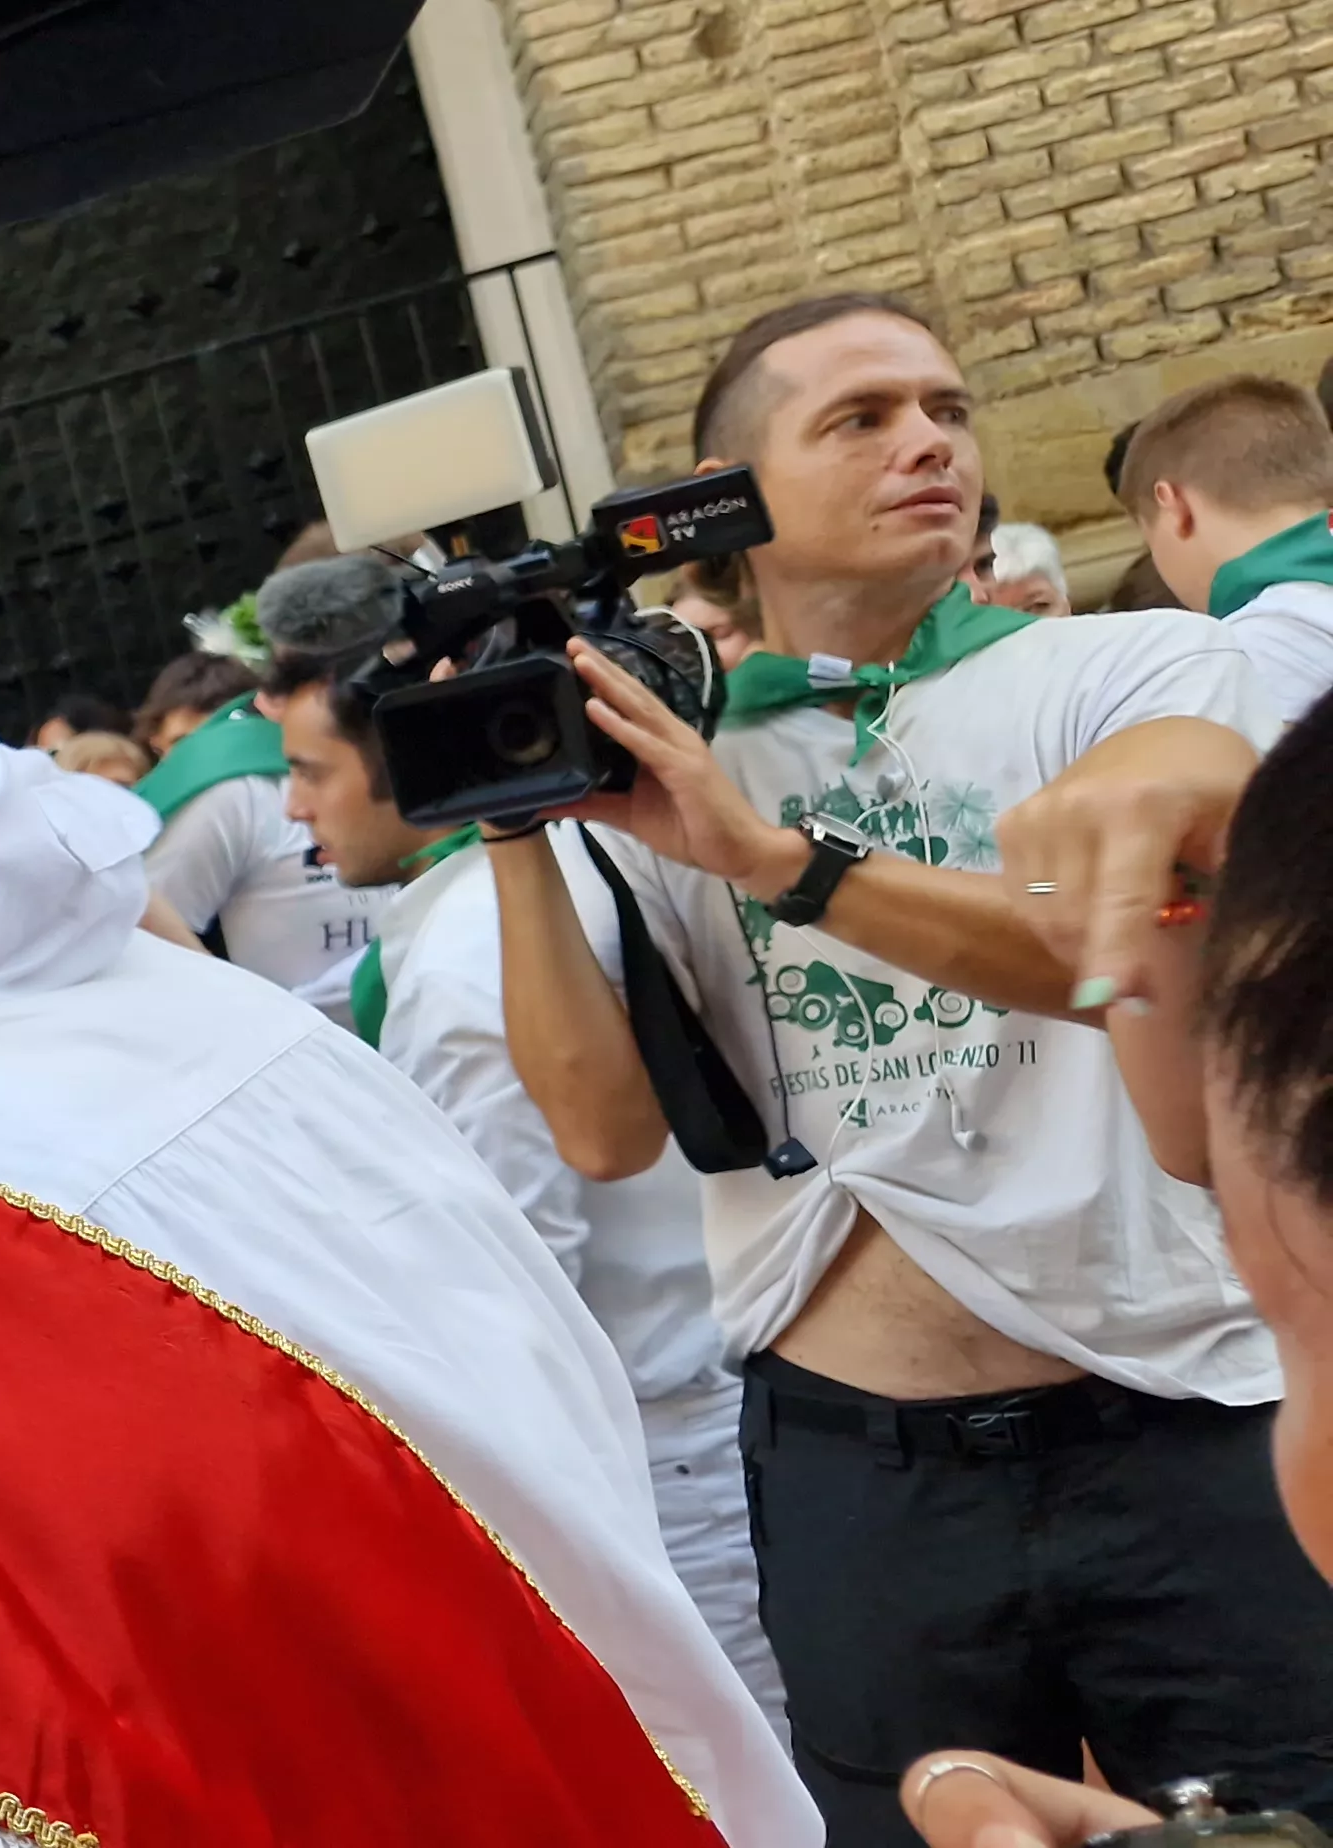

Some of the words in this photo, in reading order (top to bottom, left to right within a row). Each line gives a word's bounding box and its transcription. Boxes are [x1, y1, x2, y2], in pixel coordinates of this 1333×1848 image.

[669, 523, 697, 541] TV
[437, 576, 474, 594] SONY
[835, 1061, 863, 1086] DE
[871, 1056, 911, 1082] SAN
